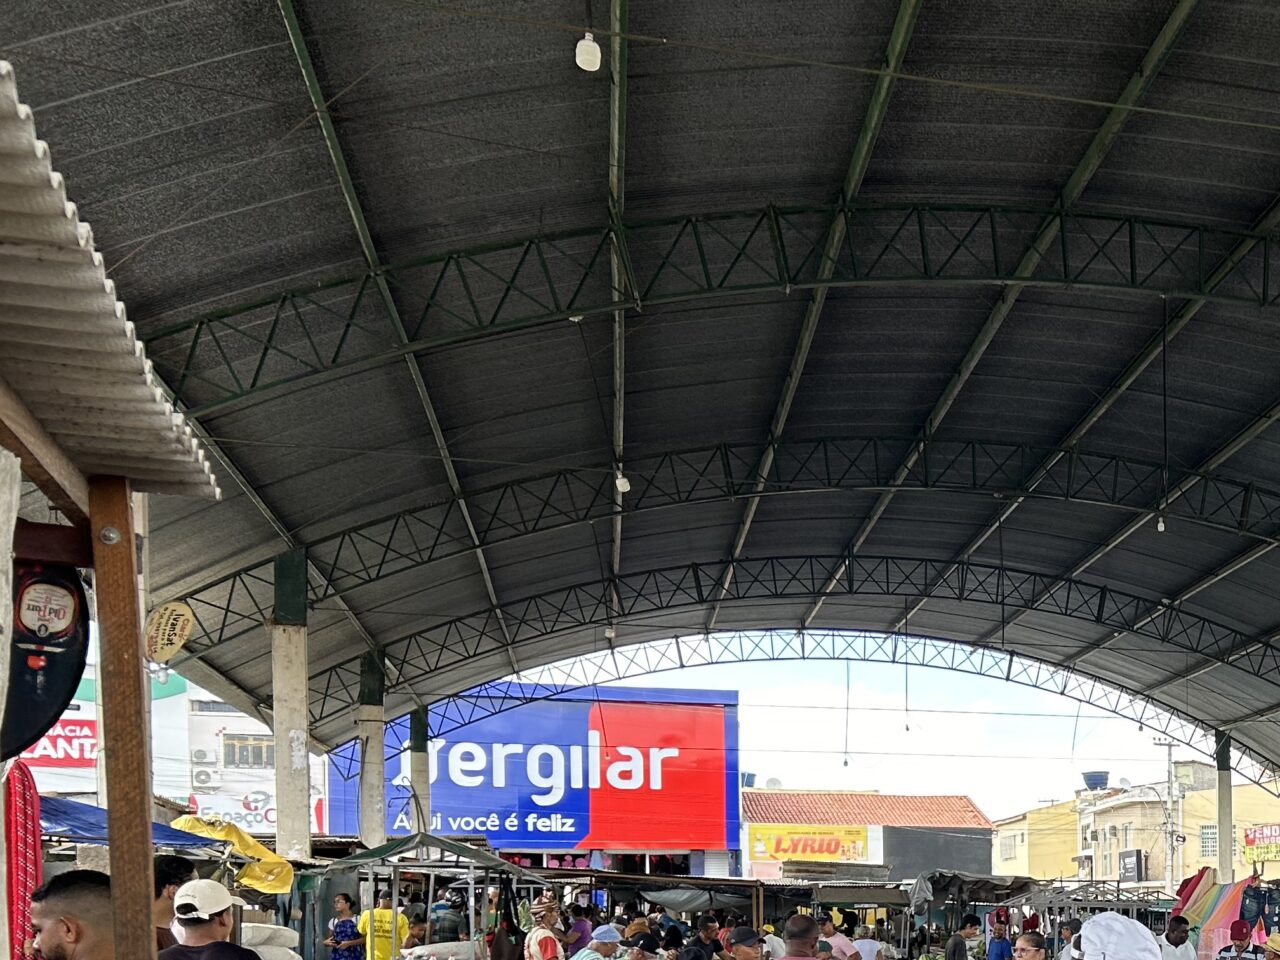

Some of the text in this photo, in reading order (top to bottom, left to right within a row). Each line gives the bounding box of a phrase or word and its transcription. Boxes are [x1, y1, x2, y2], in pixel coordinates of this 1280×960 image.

[165, 613, 185, 647] IvanSat
[448, 814, 499, 831] você
[505, 813, 517, 831] é
[525, 814, 575, 832] feliz
[774, 835, 840, 854] LYRIO
